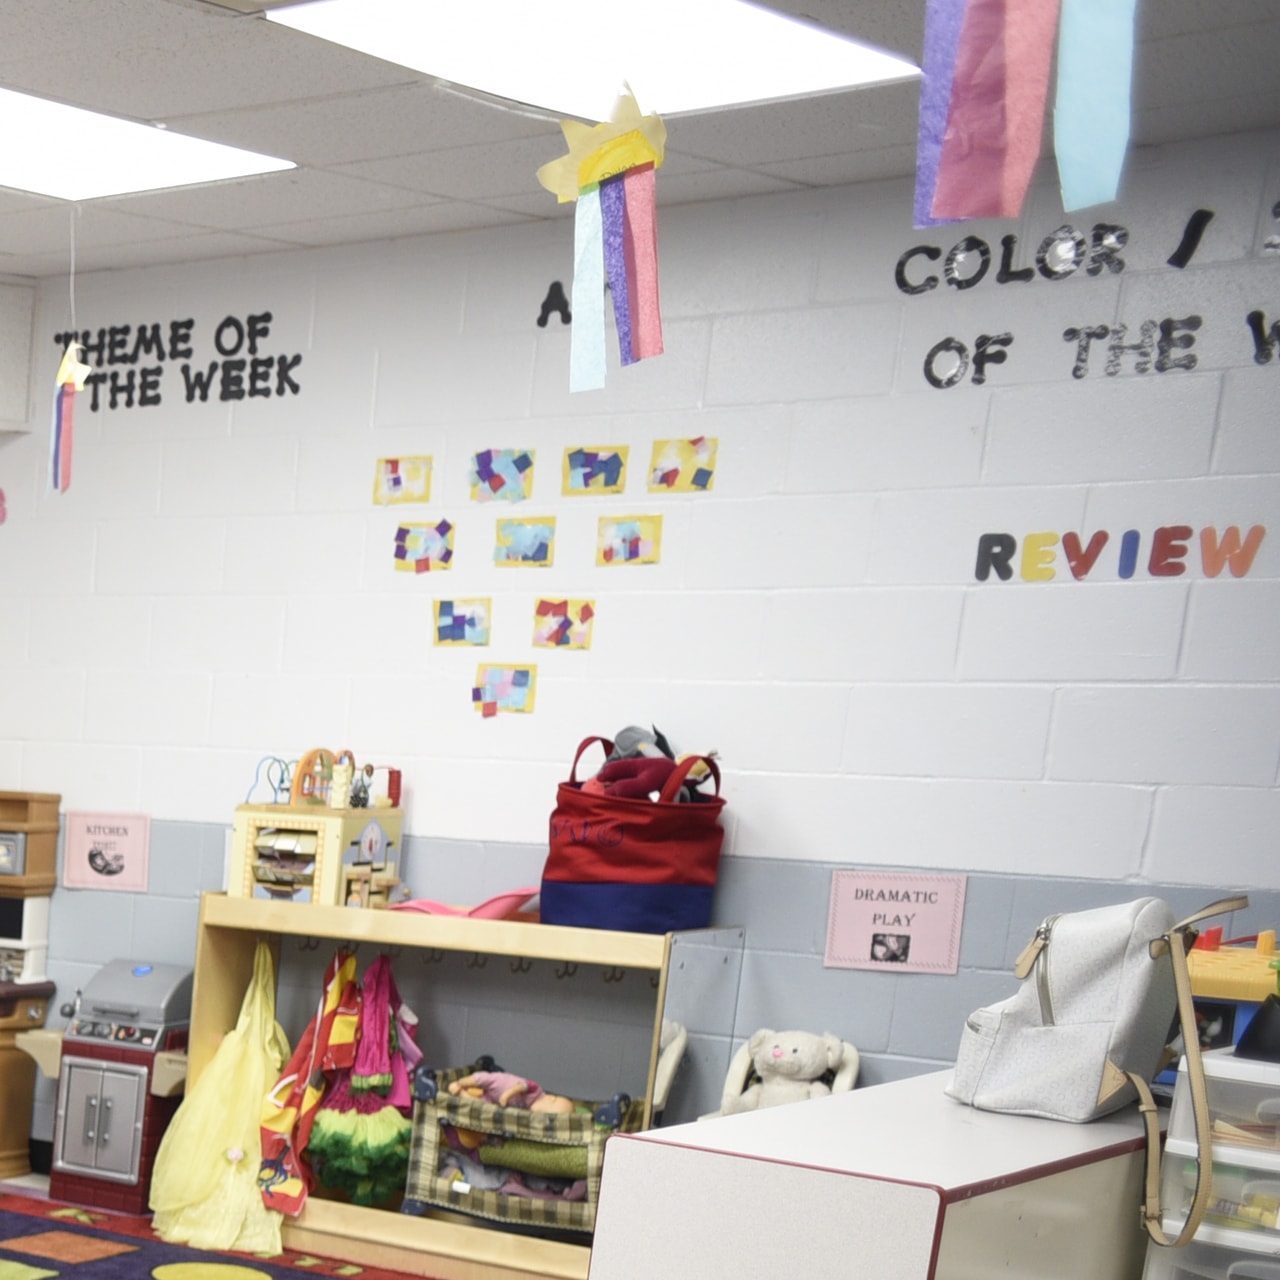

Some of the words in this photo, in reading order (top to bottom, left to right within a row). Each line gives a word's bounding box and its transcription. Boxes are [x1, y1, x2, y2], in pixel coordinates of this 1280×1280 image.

[895, 222, 1130, 295] COLOR
[54, 318, 194, 367] THEME
[214, 311, 272, 357] OF
[924, 331, 1014, 389] OF
[1063, 314, 1203, 380] THE
[84, 365, 163, 412] THE
[181, 353, 302, 403] WEEK
[975, 524, 1266, 582] REVIEW
[86, 824, 129, 837] KITCHEN
[854, 888, 938, 904] DRAMATIC
[872, 913, 916, 927] PLAY
